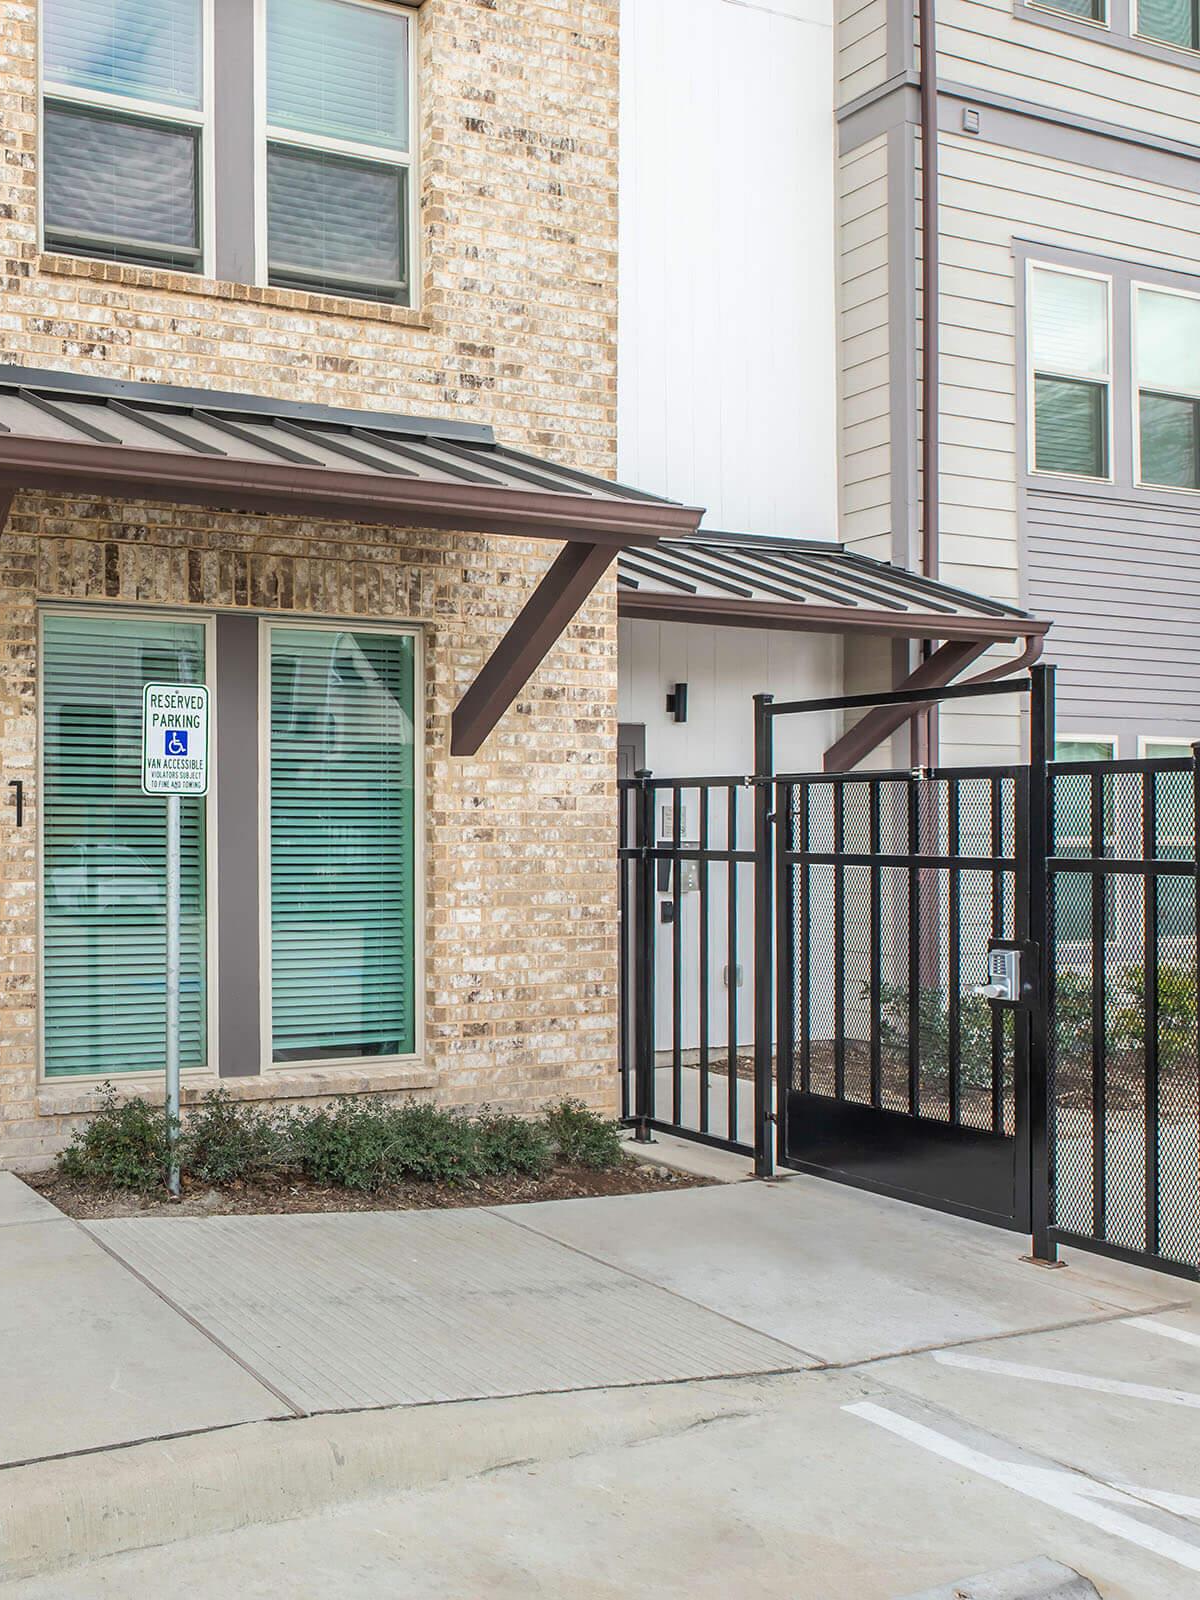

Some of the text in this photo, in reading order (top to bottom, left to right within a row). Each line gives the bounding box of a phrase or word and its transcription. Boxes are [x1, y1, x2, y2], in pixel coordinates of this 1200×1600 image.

[150, 694, 204, 710] RESERVED
[152, 713, 201, 729] PARKING
[147, 758, 204, 770] VAN ACCESSIBLE
